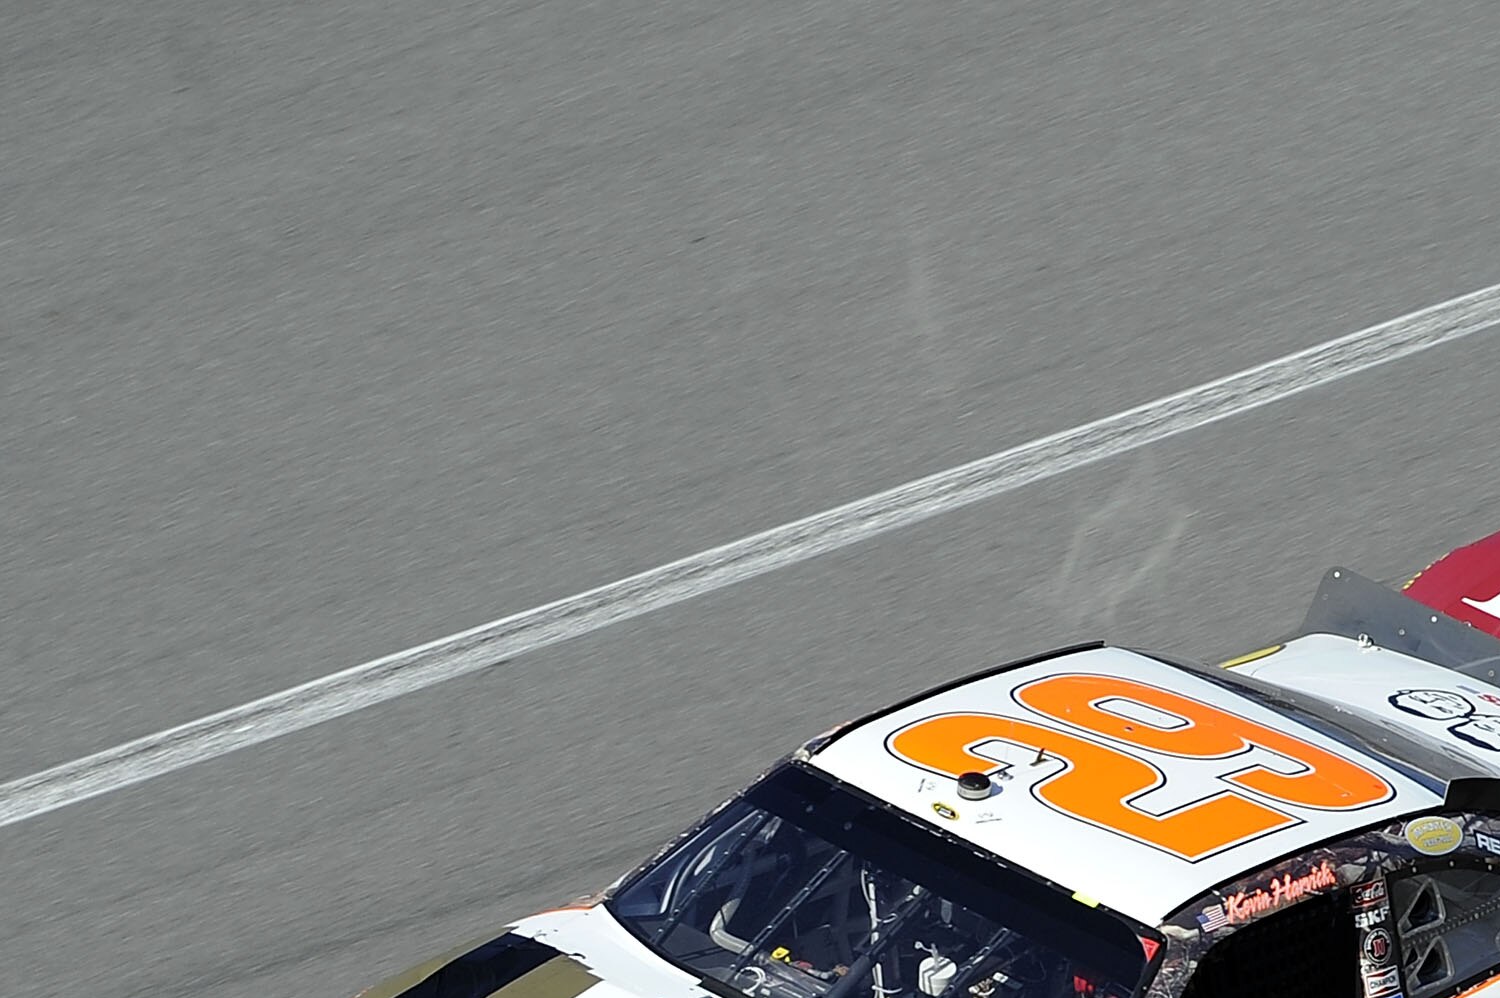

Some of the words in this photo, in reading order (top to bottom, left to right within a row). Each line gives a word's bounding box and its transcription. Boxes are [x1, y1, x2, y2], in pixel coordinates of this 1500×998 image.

[883, 672, 1396, 864] 29
[1225, 888, 1271, 923] Kevin
[1270, 861, 1337, 906] Harvick
[1355, 907, 1390, 928] SKF
